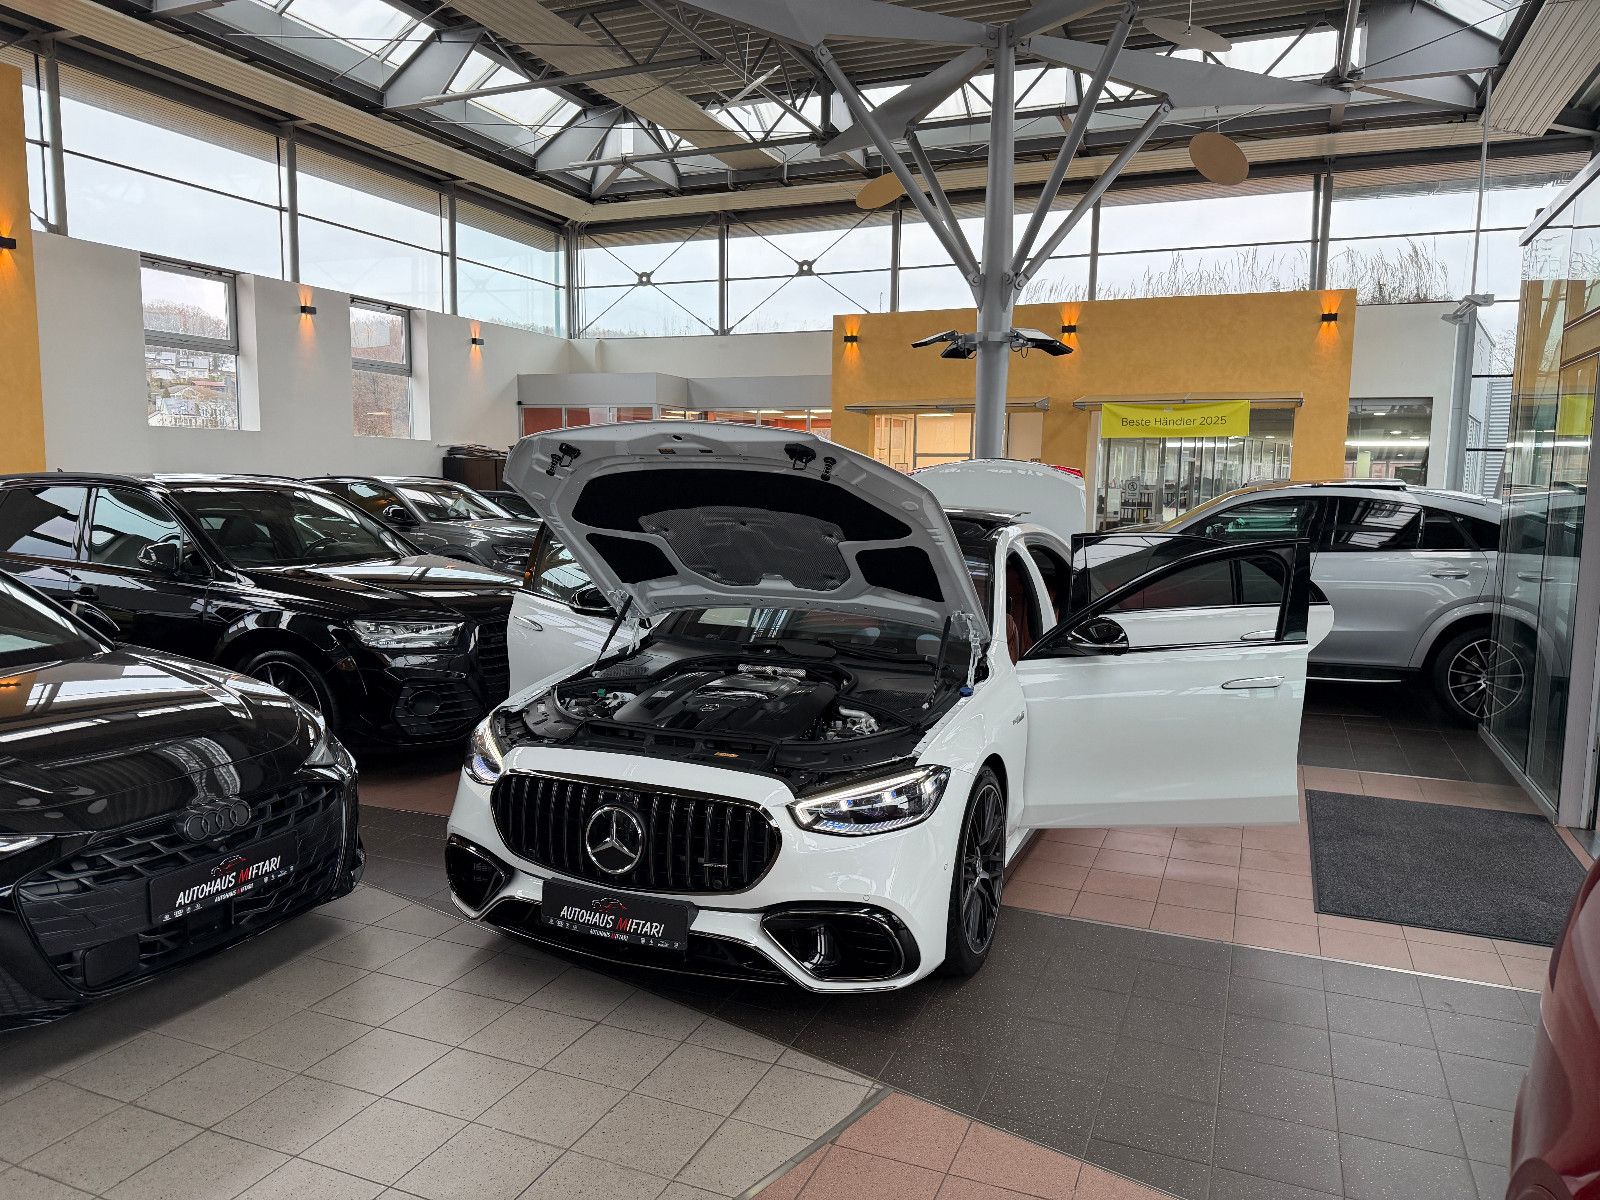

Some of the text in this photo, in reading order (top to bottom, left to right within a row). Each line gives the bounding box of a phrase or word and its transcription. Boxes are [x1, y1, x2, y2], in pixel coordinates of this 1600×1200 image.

[1121, 415, 1227, 427] Beste Händler 2025
[175, 872, 236, 907] AUTOHAUS
[238, 855, 281, 884] MIFTARI
[560, 905, 615, 928] AUTOHAUS
[616, 917, 665, 938] MIFTARI
